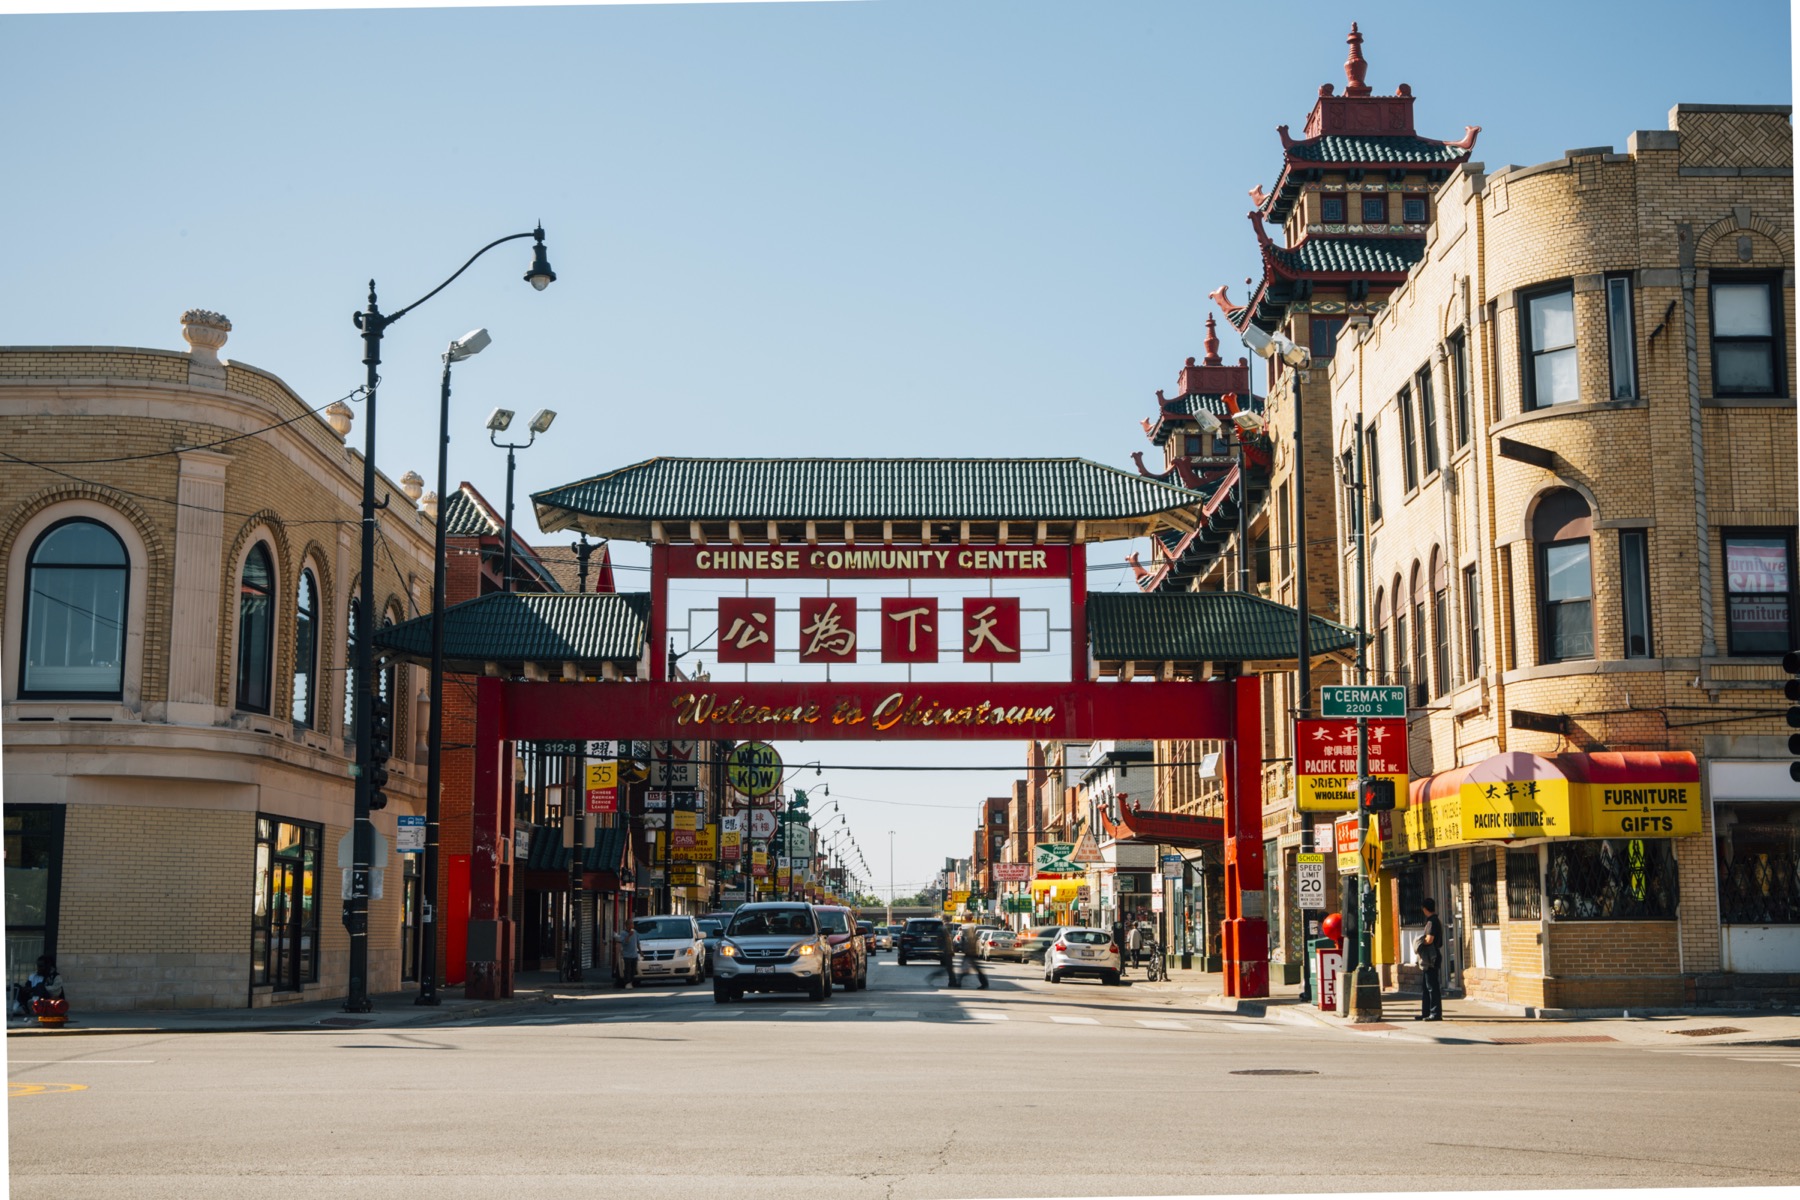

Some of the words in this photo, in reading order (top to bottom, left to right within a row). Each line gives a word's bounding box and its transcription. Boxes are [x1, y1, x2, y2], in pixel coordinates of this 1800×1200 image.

[696, 551, 800, 569] CHINESE
[810, 550, 949, 570] COMMUNITY
[958, 550, 1047, 569] CENTER
[1323, 692, 1331, 701] W
[1335, 690, 1388, 702] CERMAK
[1391, 691, 1403, 700] RD
[672, 693, 821, 725] Welcome
[833, 700, 865, 725] to
[872, 693, 1056, 731] Chinatown
[1346, 704, 1371, 713] 2200
[1376, 704, 1383, 713] S
[1312, 726, 1391, 743] 太平洋
[737, 751, 773, 768] WON
[1305, 760, 1337, 773] PACIFIC
[1340, 760, 1386, 773] FURURE
[592, 766, 612, 783] 35
[738, 771, 773, 788] KOW
[1315, 791, 1356, 800] WHOLESALE
[1486, 782, 1541, 801] 太平洋
[1604, 789, 1688, 805] FURNITURE
[1474, 813, 1501, 828] PACIFIC
[1504, 812, 1544, 827] FURNITURE
[1621, 816, 1673, 832] GIFTS
[1300, 864, 1322, 872] SPEED
[1301, 879, 1322, 892] 20
